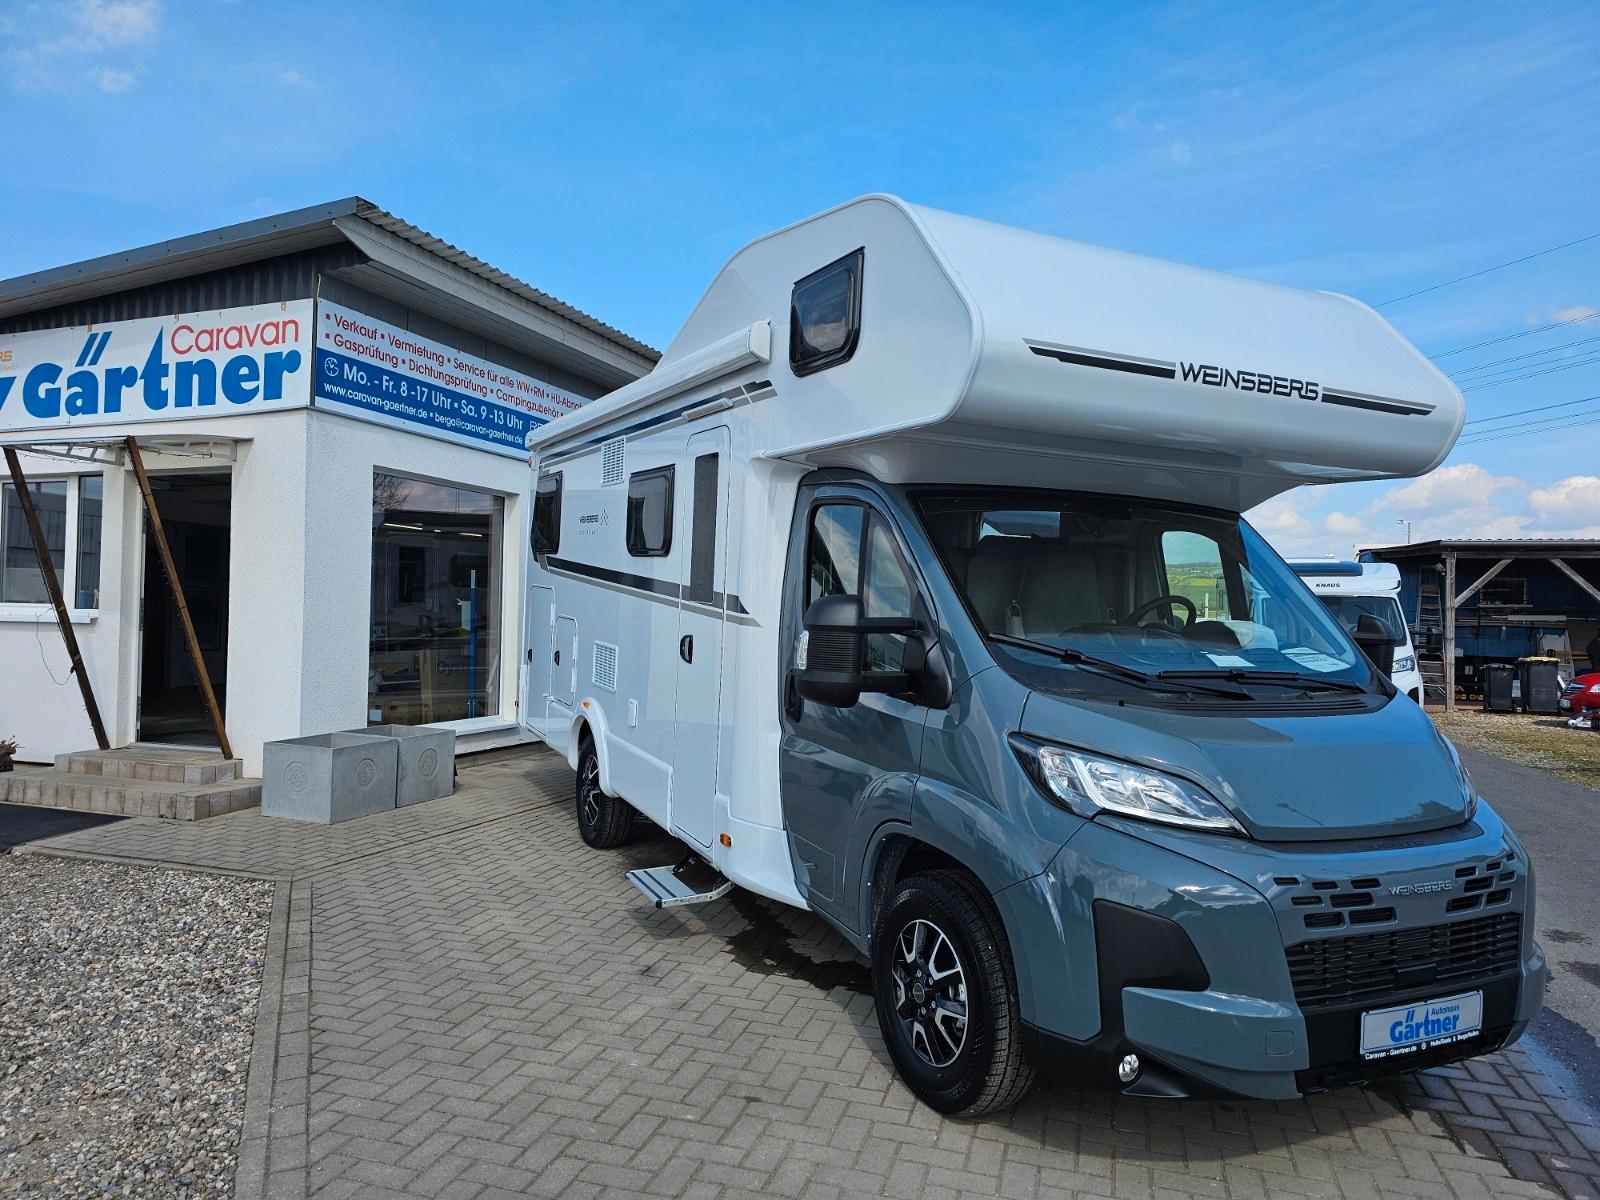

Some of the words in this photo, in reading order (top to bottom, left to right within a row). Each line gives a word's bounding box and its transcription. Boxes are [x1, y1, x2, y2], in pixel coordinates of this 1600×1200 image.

[171, 319, 299, 355] Caravan
[334, 313, 377, 340] Verkauf
[388, 333, 445, 367] Vermietung
[453, 357, 486, 378] Service
[487, 370, 499, 383] für
[500, 376, 515, 388] alle
[22, 324, 302, 419] Gärtner
[333, 333, 399, 368] Gasprüfung
[408, 358, 488, 397] Dichtungsprüfung
[496, 388, 559, 418] Campingzubehör
[343, 363, 371, 386] Mo.
[382, 375, 397, 394] Fr.
[400, 381, 408, 396] 8
[432, 390, 451, 410] Uhr
[460, 400, 477, 418] Sa.
[481, 407, 487, 420] 9
[507, 415, 523, 431] Uhr
[1180, 361, 1319, 401] WEINSBERG
[324, 382, 428, 418] www.caravan-gaertner.de
[434, 412, 523, 445] berga@caravan-gaertner.de
[1389, 1008, 1460, 1044] Gärtner
[1431, 1004, 1460, 1016] Autohaus
